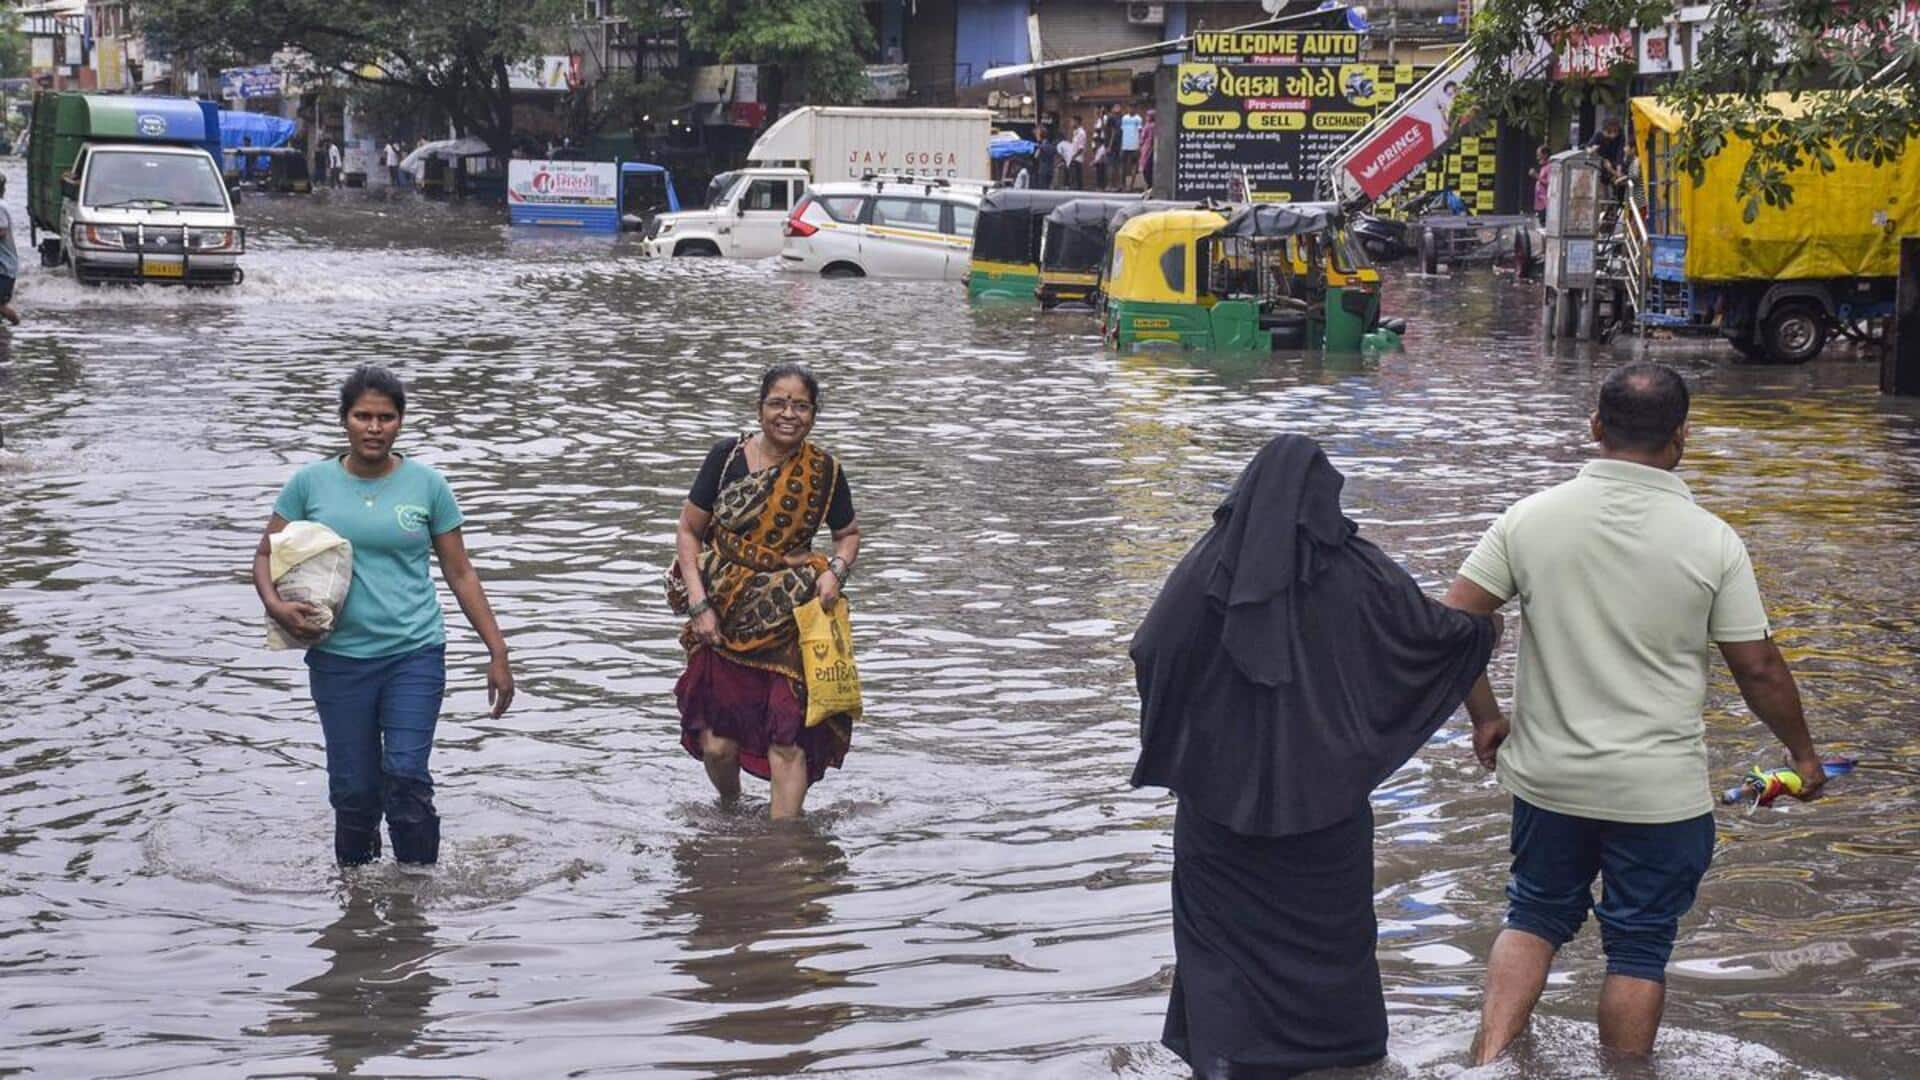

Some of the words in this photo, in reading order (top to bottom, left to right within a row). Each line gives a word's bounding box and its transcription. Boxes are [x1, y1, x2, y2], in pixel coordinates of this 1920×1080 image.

[1197, 34, 1298, 53] WELCOME
[1302, 34, 1357, 53] AUTO
[1220, 67, 1280, 97] વેલકમ
[1286, 67, 1336, 97] ઓટો
[1248, 100, 1307, 110] Pre-owned
[1197, 114, 1225, 126] BUY
[1261, 115, 1291, 127] SELL
[1376, 124, 1422, 167] PRINCE
[849, 151, 888, 163] JAY
[905, 151, 957, 165] GOGA
